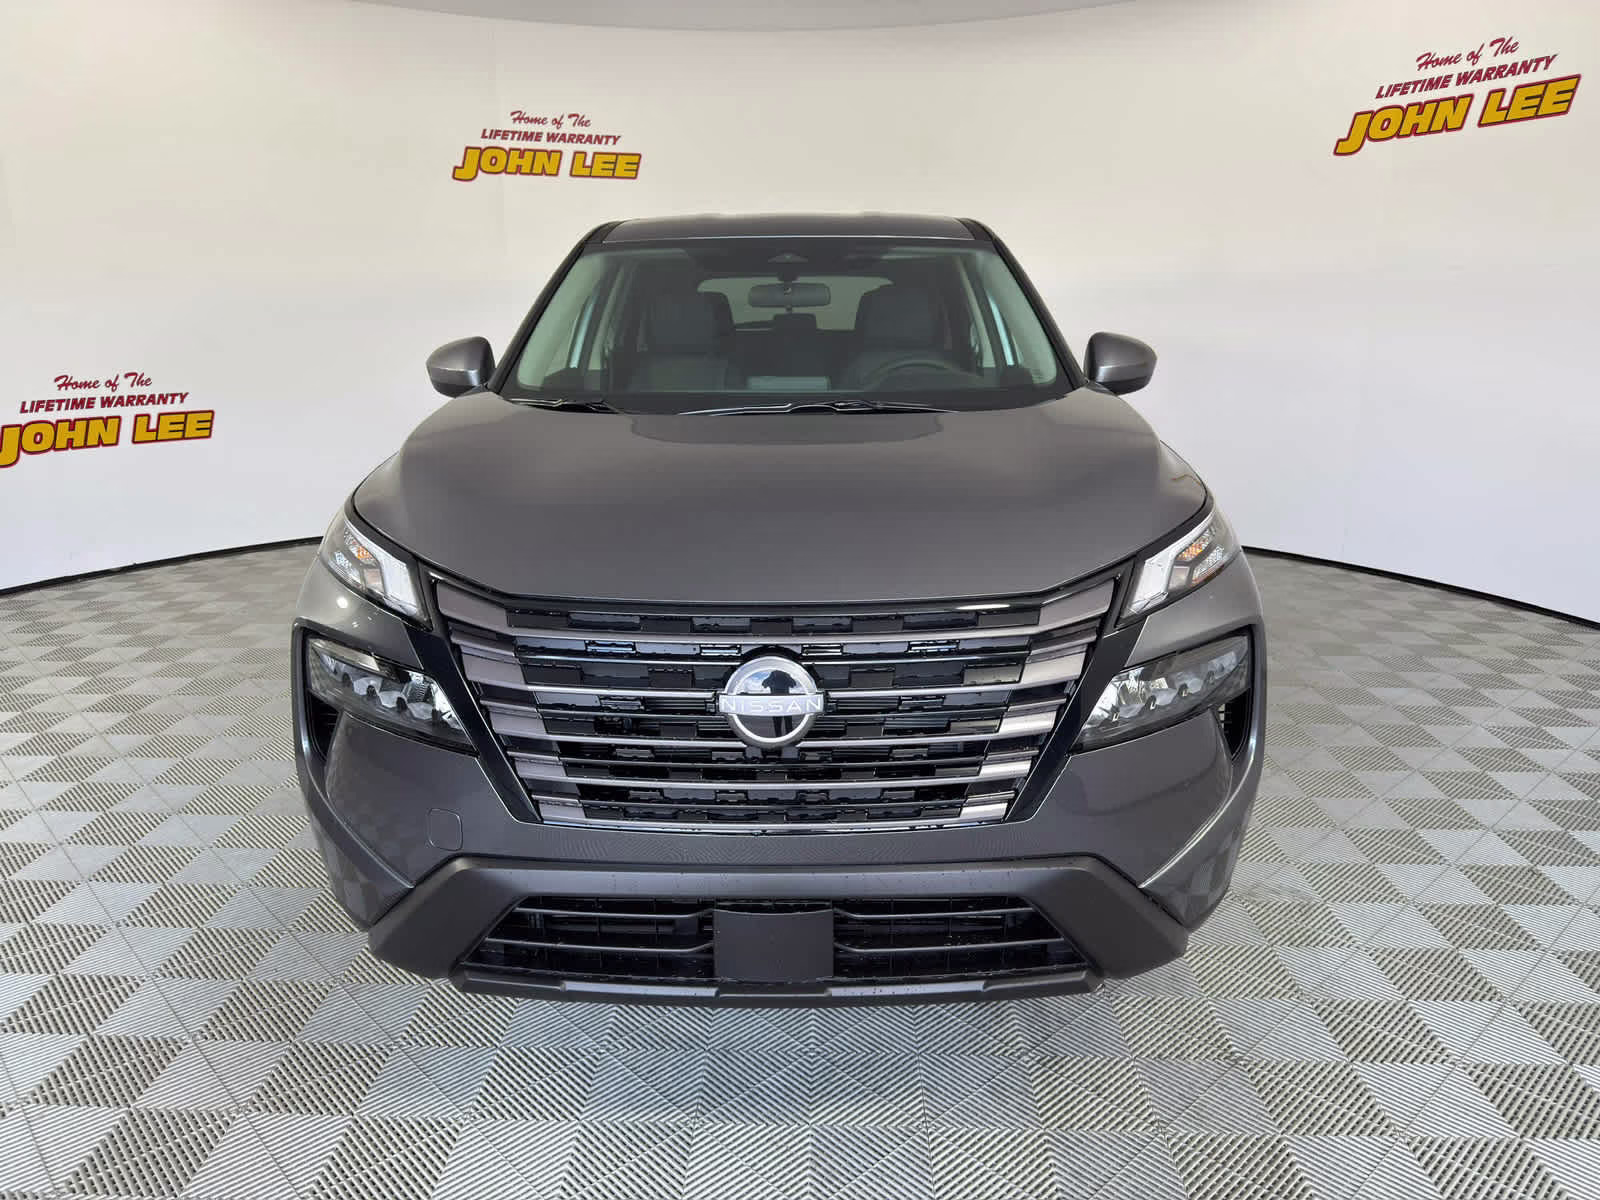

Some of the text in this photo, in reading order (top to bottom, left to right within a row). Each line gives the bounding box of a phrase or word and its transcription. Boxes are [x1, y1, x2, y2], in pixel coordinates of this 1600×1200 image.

[1416, 36, 1519, 71] Home of The
[1375, 54, 1558, 99] LIFETIME WARRANTY
[510, 110, 591, 129] Home of The
[1333, 74, 1581, 156] JOHN LEE
[480, 128, 621, 145] LIFETIME WARRANTY
[452, 146, 642, 182] JOHN LEE
[54, 372, 152, 392] Home of The
[20, 392, 189, 414] LIFETIME WARRANTY
[0, 410, 215, 468] JOHN LEE
[720, 696, 821, 713] NISSAN
